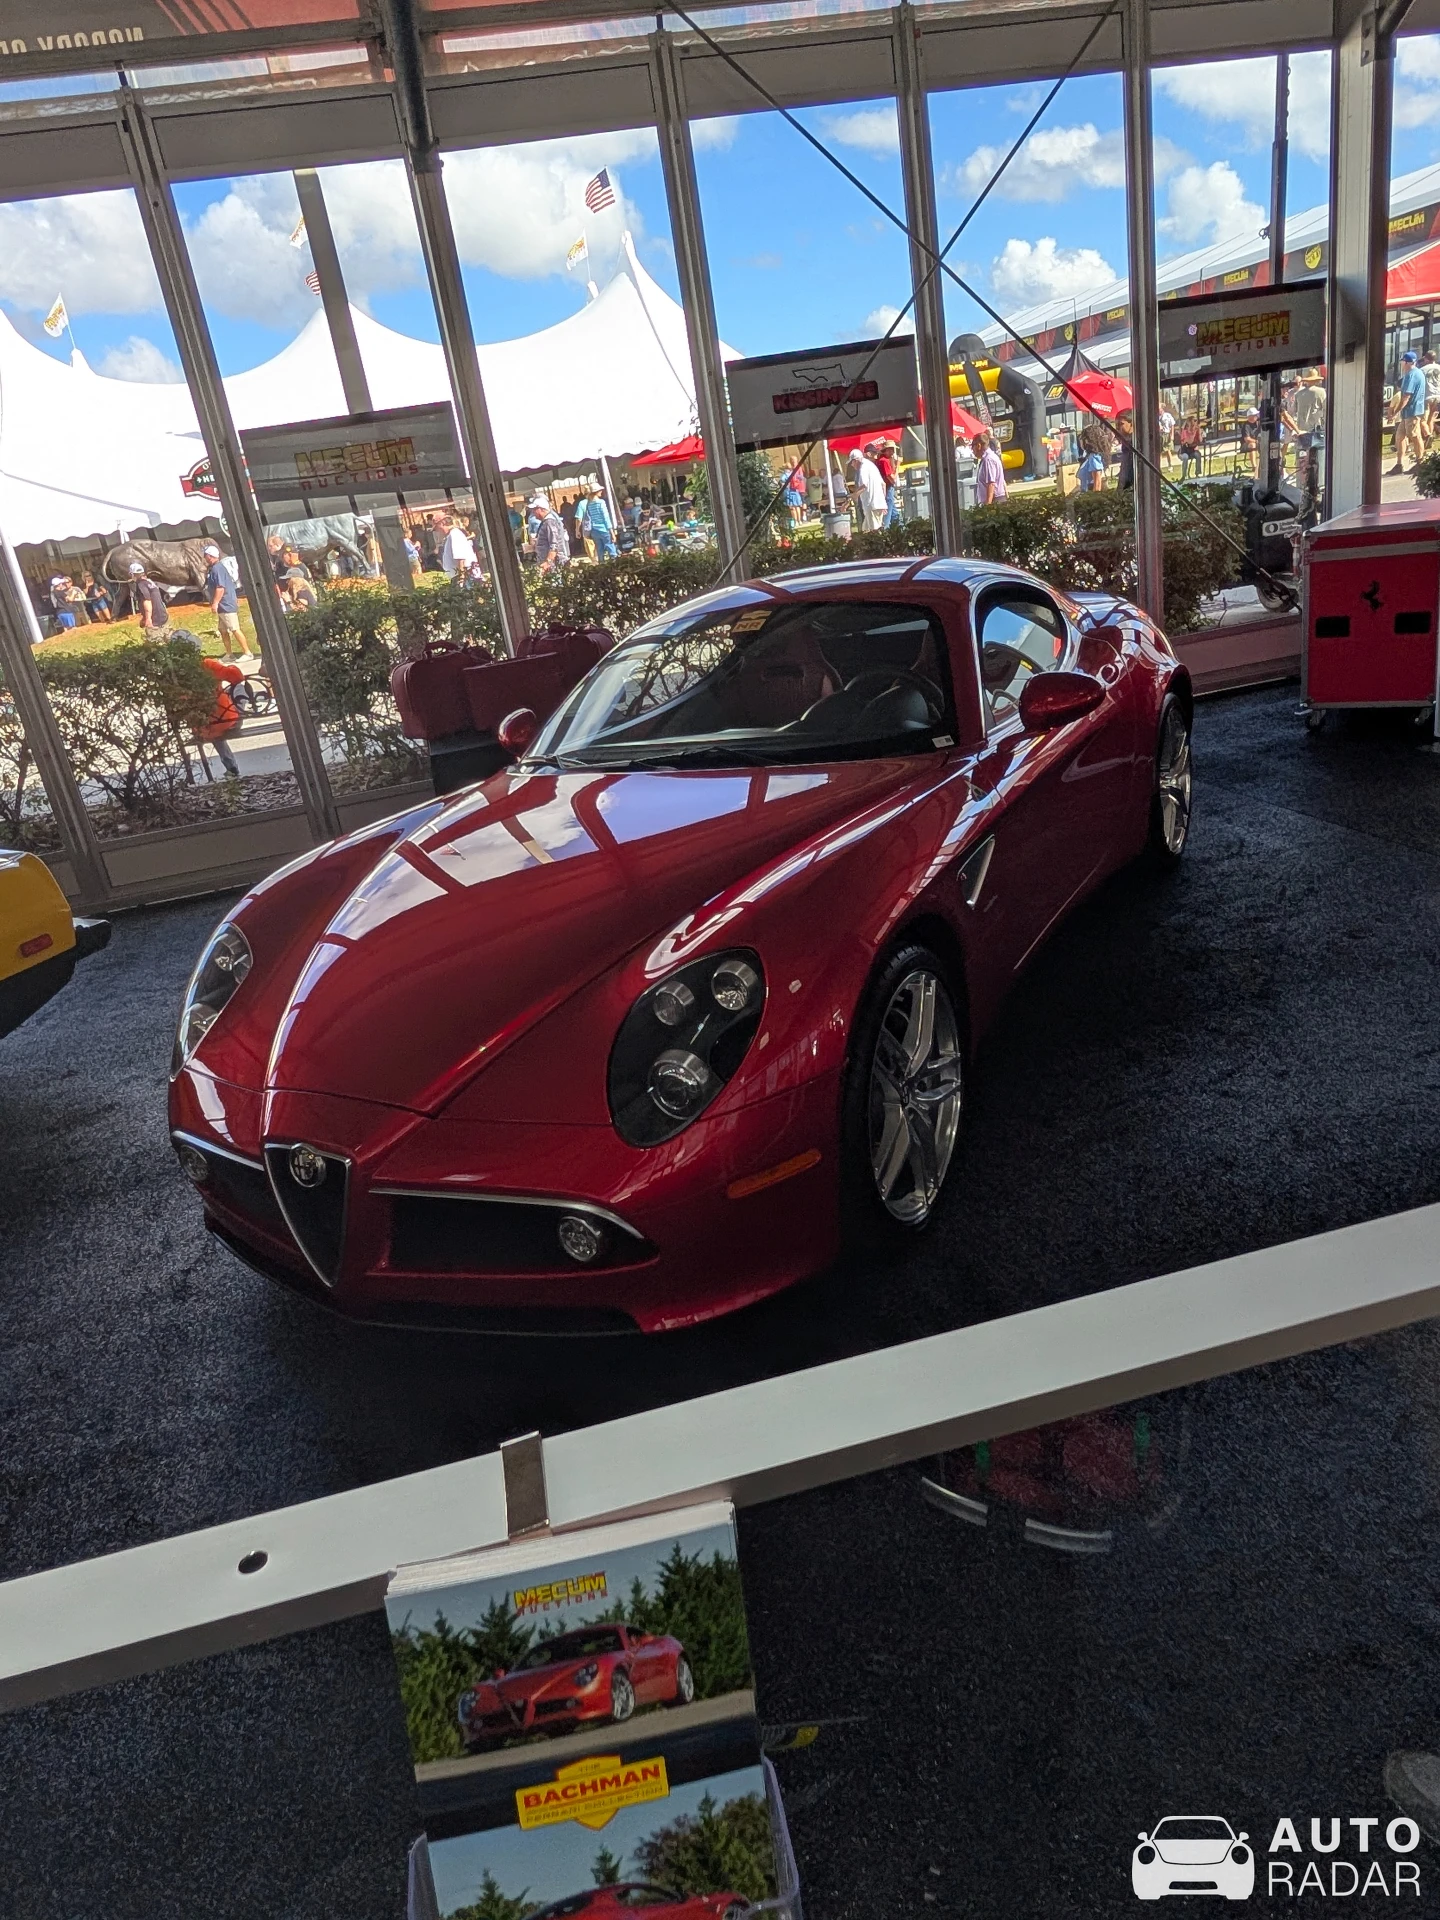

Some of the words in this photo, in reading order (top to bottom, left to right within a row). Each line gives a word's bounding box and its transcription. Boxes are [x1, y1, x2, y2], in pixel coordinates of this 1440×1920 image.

[1389, 210, 1425, 233] MECUM
[1196, 310, 1290, 347] MECUM
[1196, 336, 1290, 357] AUCTIONS
[294, 437, 416, 478] MECUM
[300, 464, 419, 490] AUCTIONS
[514, 1570, 607, 1609] MECUM
[523, 1763, 660, 1809] BACHMAN
